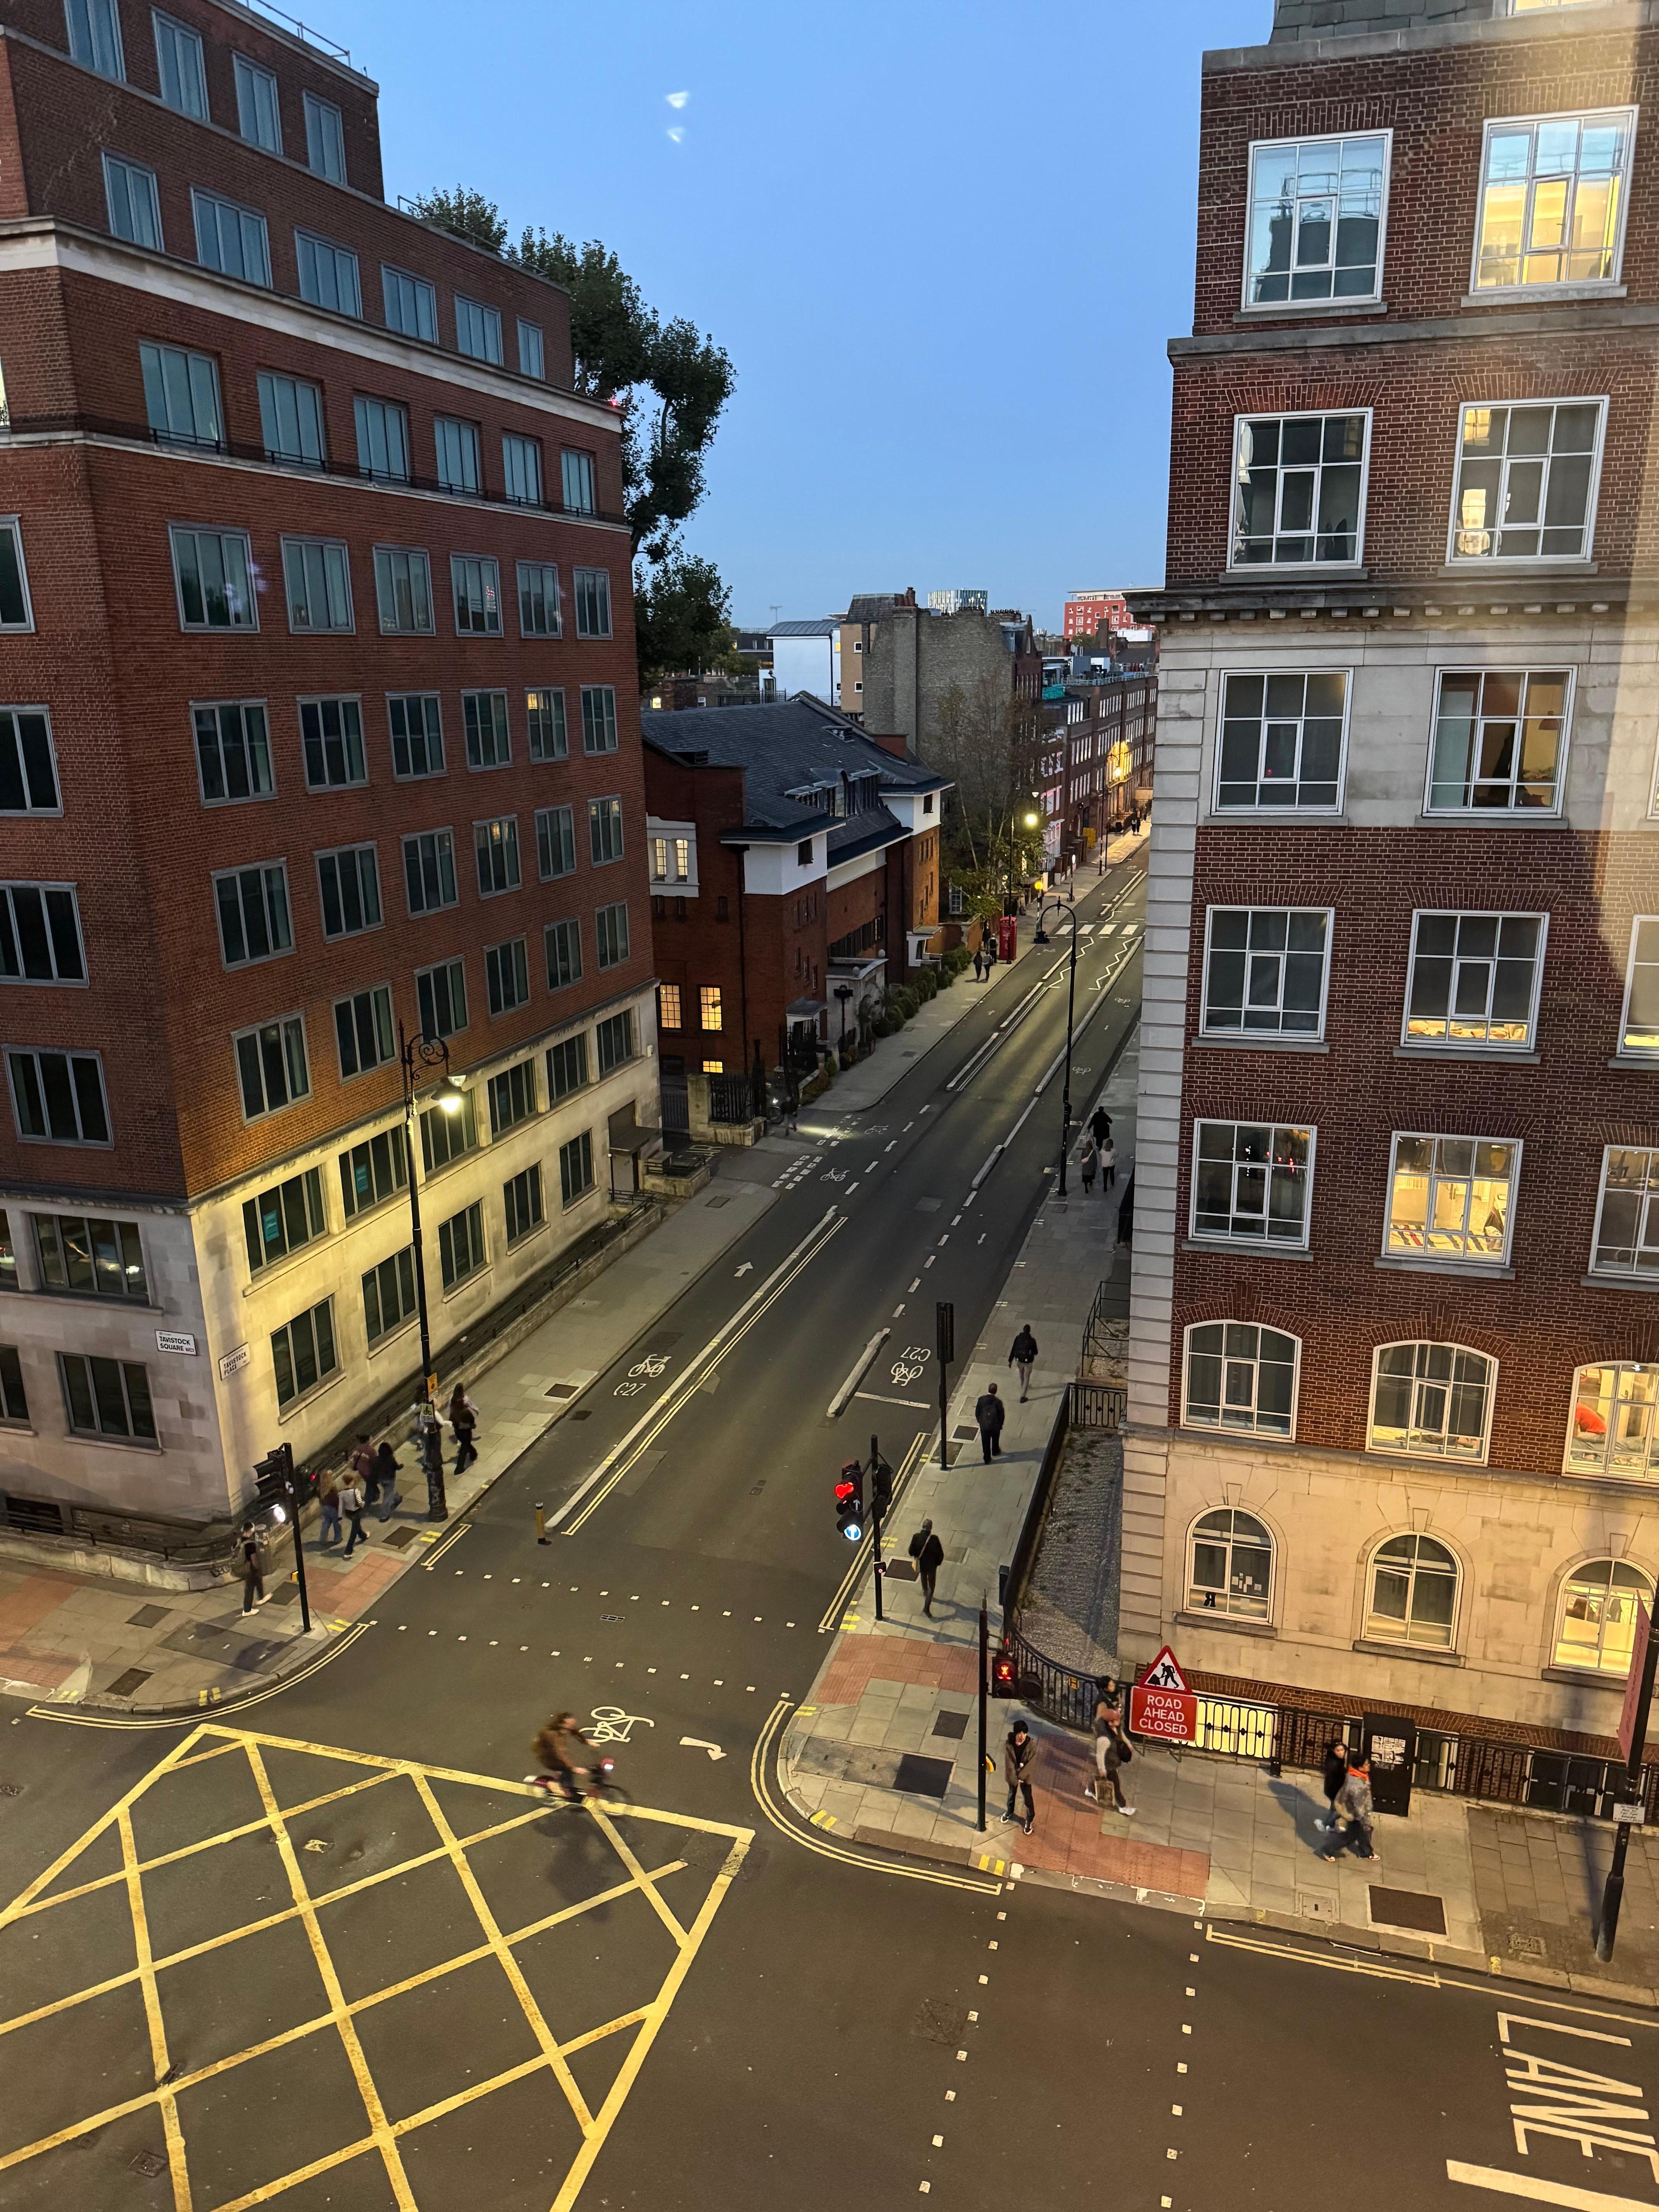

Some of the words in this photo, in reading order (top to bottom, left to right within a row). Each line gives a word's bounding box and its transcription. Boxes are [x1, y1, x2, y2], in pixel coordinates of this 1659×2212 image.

[159, 1336, 191, 1345] TAVISTOCK
[224, 1352, 247, 1369] TAVISTOCK
[900, 1346, 931, 1362] C27
[224, 1364, 237, 1376] PLACE
[1070, 1677, 1078, 1688] H
[1147, 1695, 1182, 1710] ROAD
[1143, 1707, 1185, 1722] AHEAD
[1139, 1718, 1188, 1735] CLOSED
[1497, 2011, 1659, 2184] LANE
